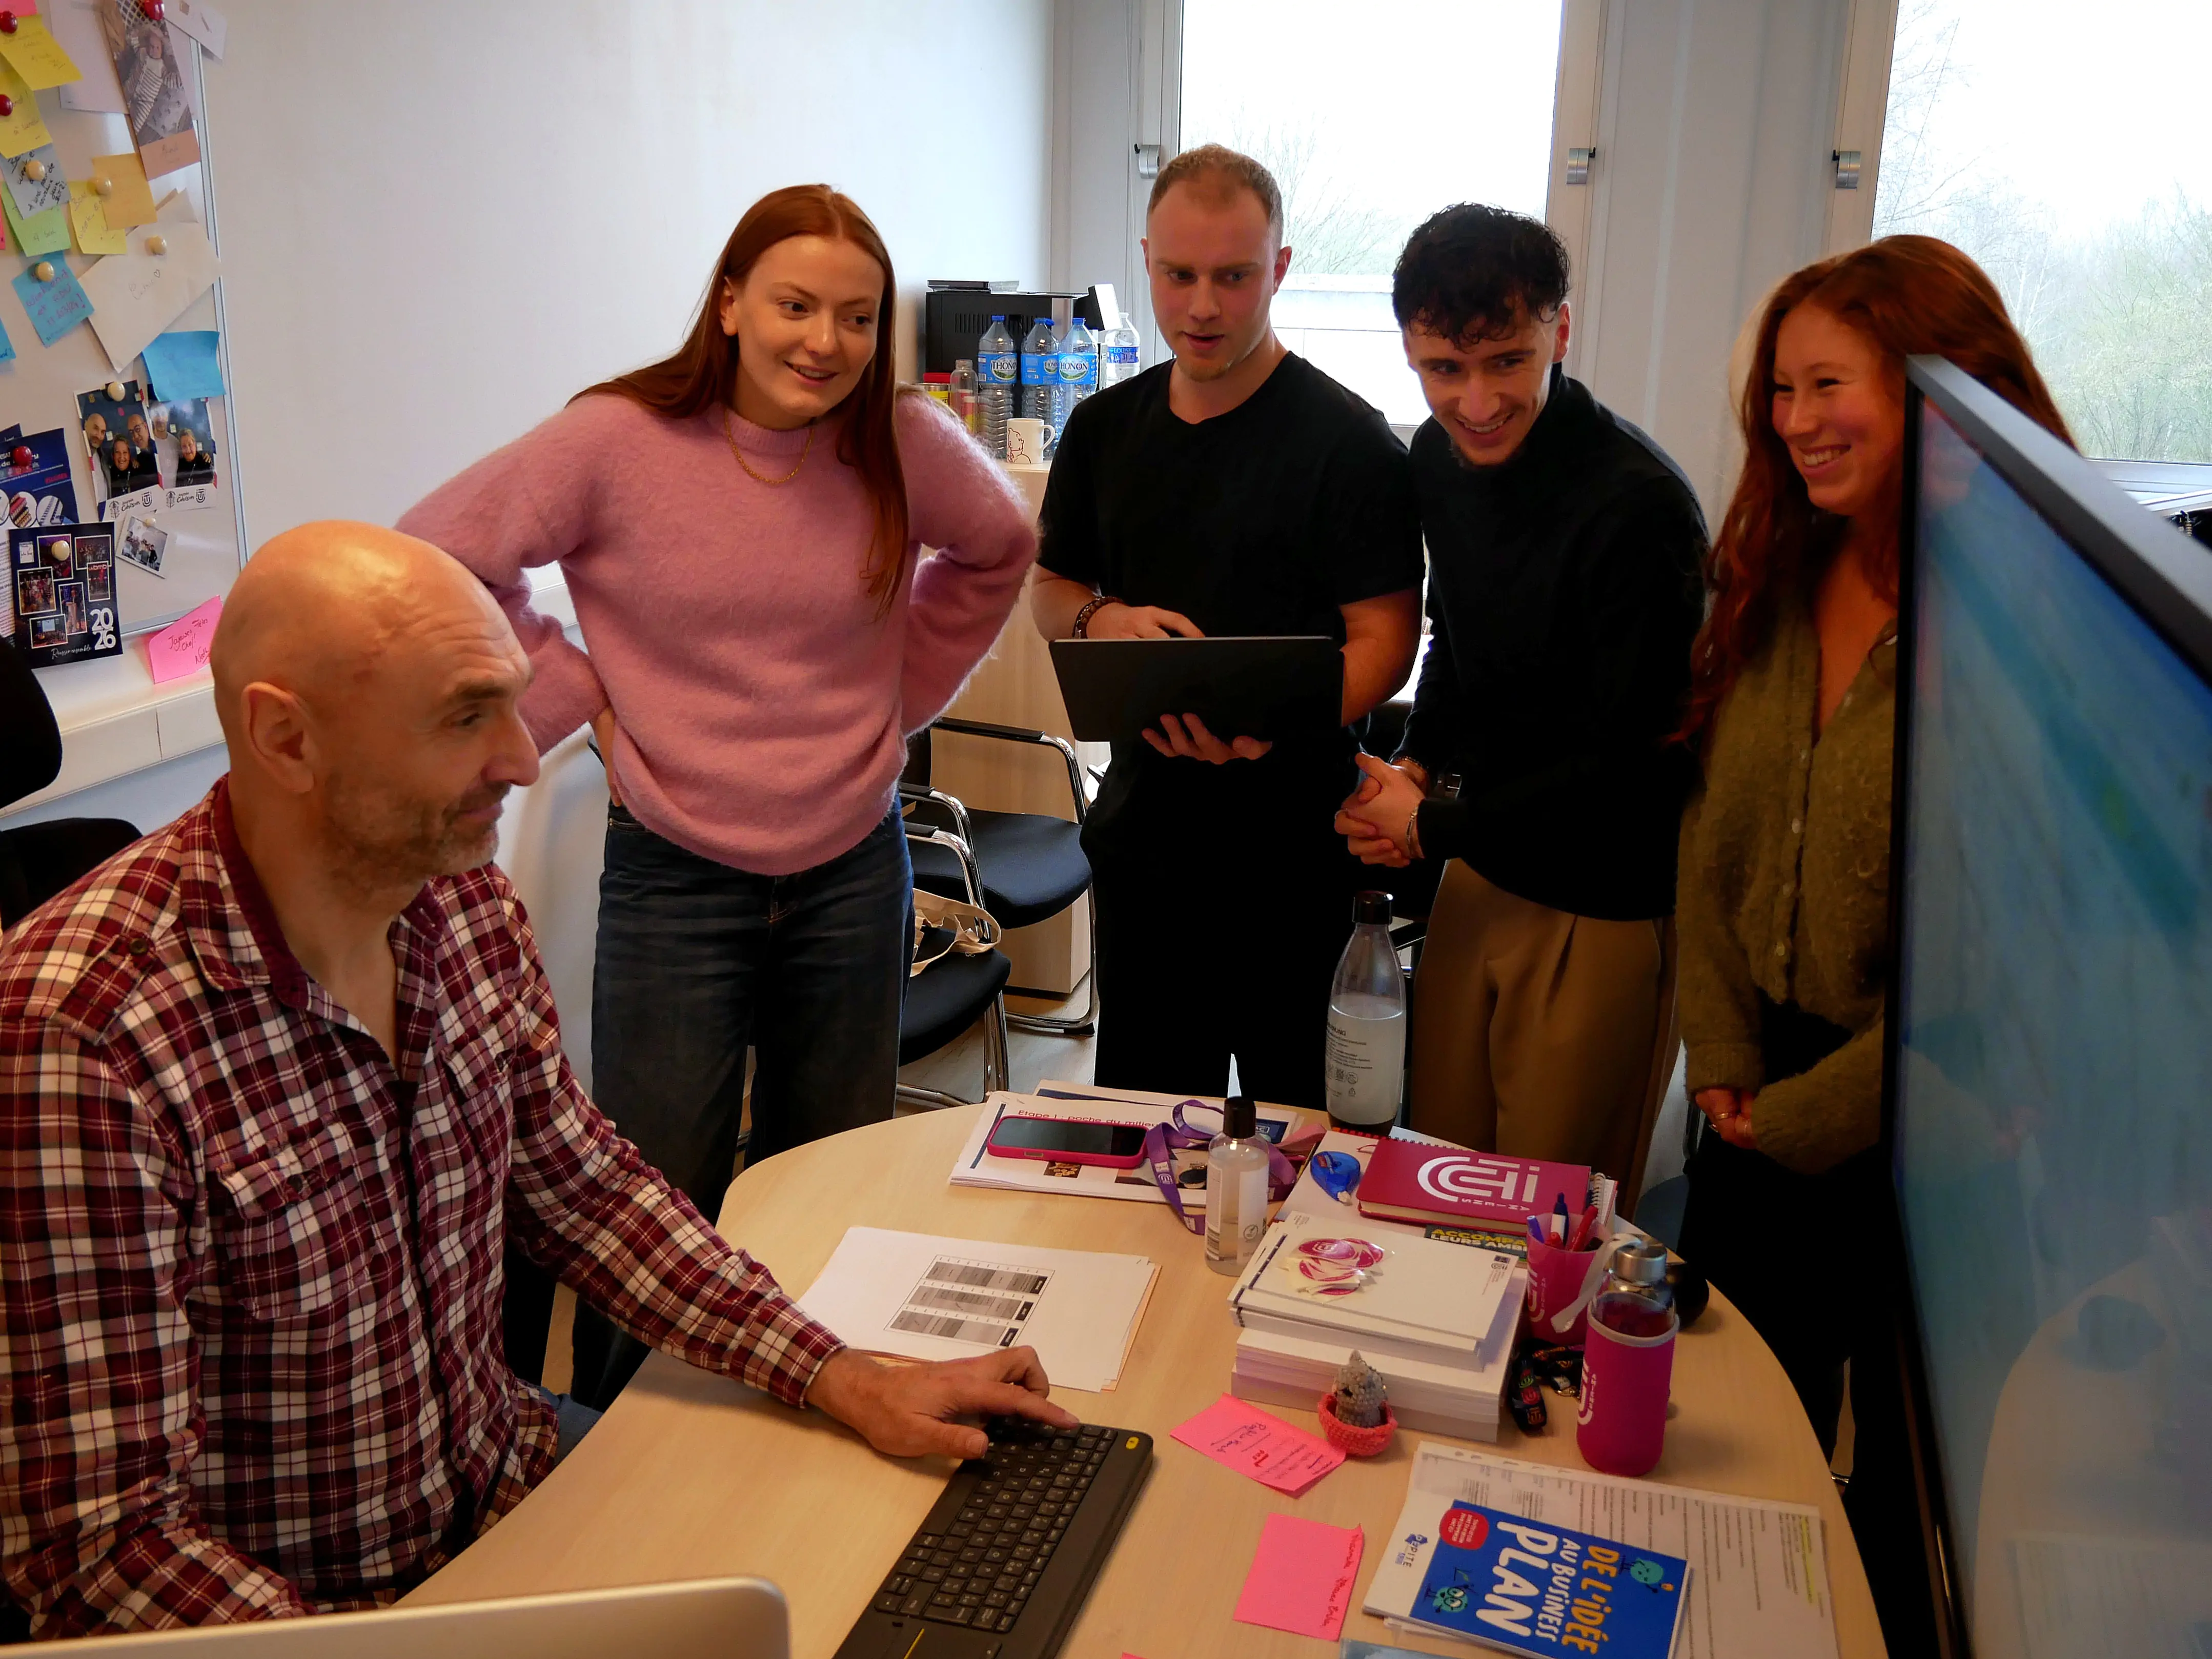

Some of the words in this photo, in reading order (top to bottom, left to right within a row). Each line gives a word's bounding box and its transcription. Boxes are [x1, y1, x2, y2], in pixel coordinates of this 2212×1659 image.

[90, 608, 114, 631] 20
[92, 626, 116, 650] 26
[1461, 1198, 1530, 1211] AMIENS
[1430, 1234, 1482, 1245] LEURS
[1559, 1537, 1582, 1563] AU
[1582, 1545, 1620, 1577] DE
[1475, 1521, 1559, 1637] PLAN
